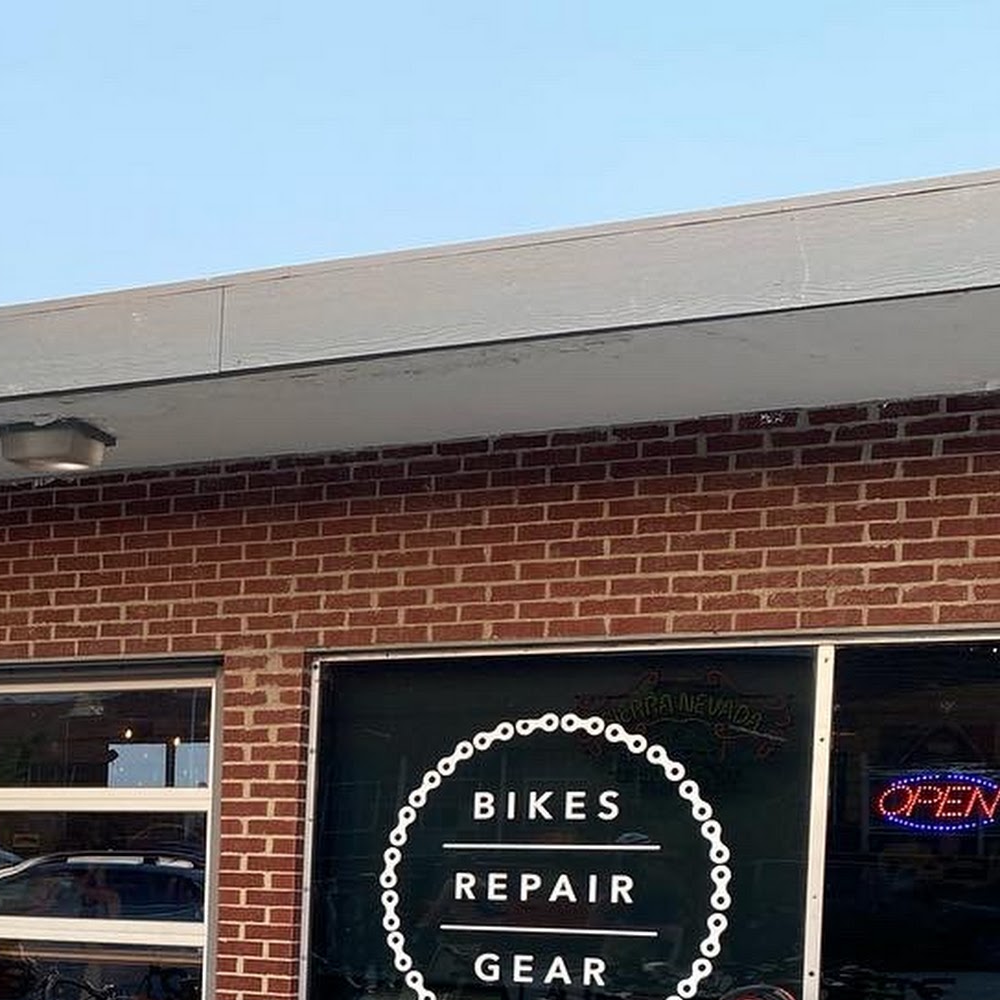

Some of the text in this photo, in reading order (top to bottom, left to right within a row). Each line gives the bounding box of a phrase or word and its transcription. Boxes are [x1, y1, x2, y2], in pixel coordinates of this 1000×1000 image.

[473, 790, 620, 821] BIKES
[878, 785, 1000, 818] OPEN
[454, 872, 634, 904] REPAIR
[474, 953, 606, 986] GEAR
